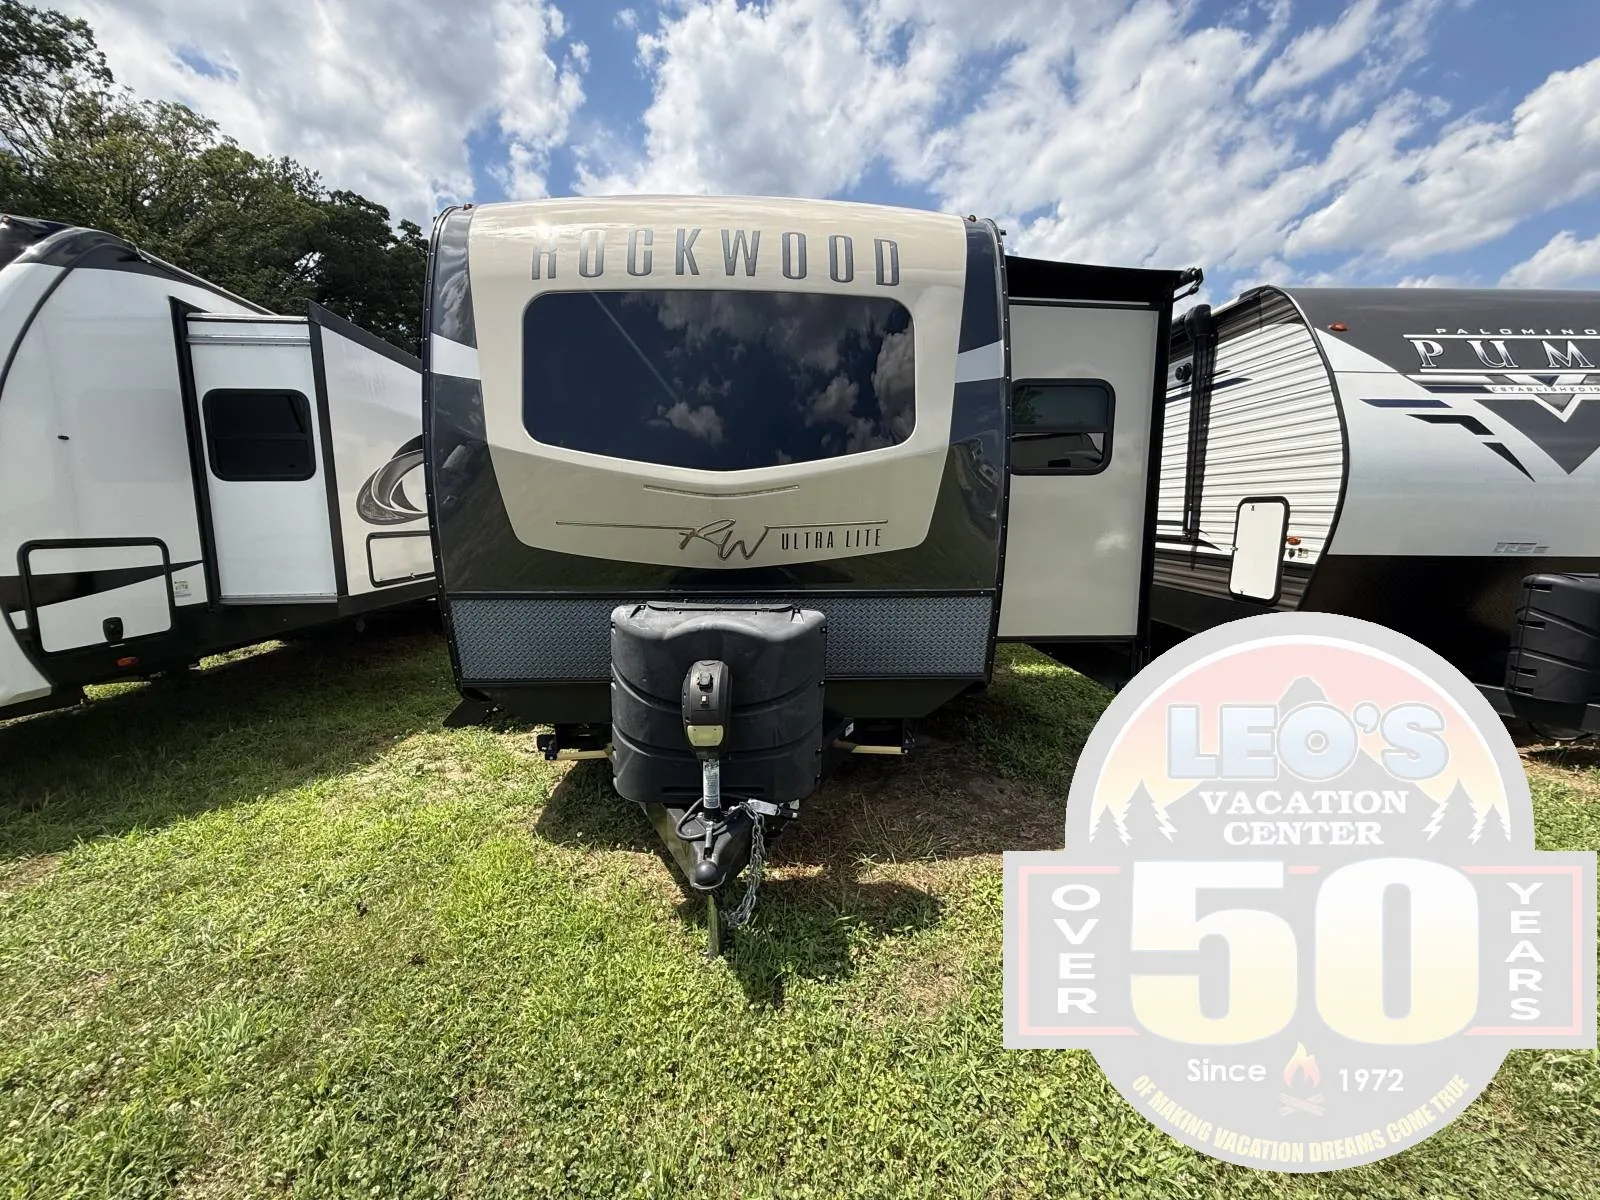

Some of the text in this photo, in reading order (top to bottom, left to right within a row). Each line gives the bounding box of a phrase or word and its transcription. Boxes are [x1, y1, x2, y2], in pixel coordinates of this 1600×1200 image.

[531, 227, 901, 287] ROCKWOOD
[781, 531, 834, 550] ULTRA
[845, 528, 881, 548] LITE
